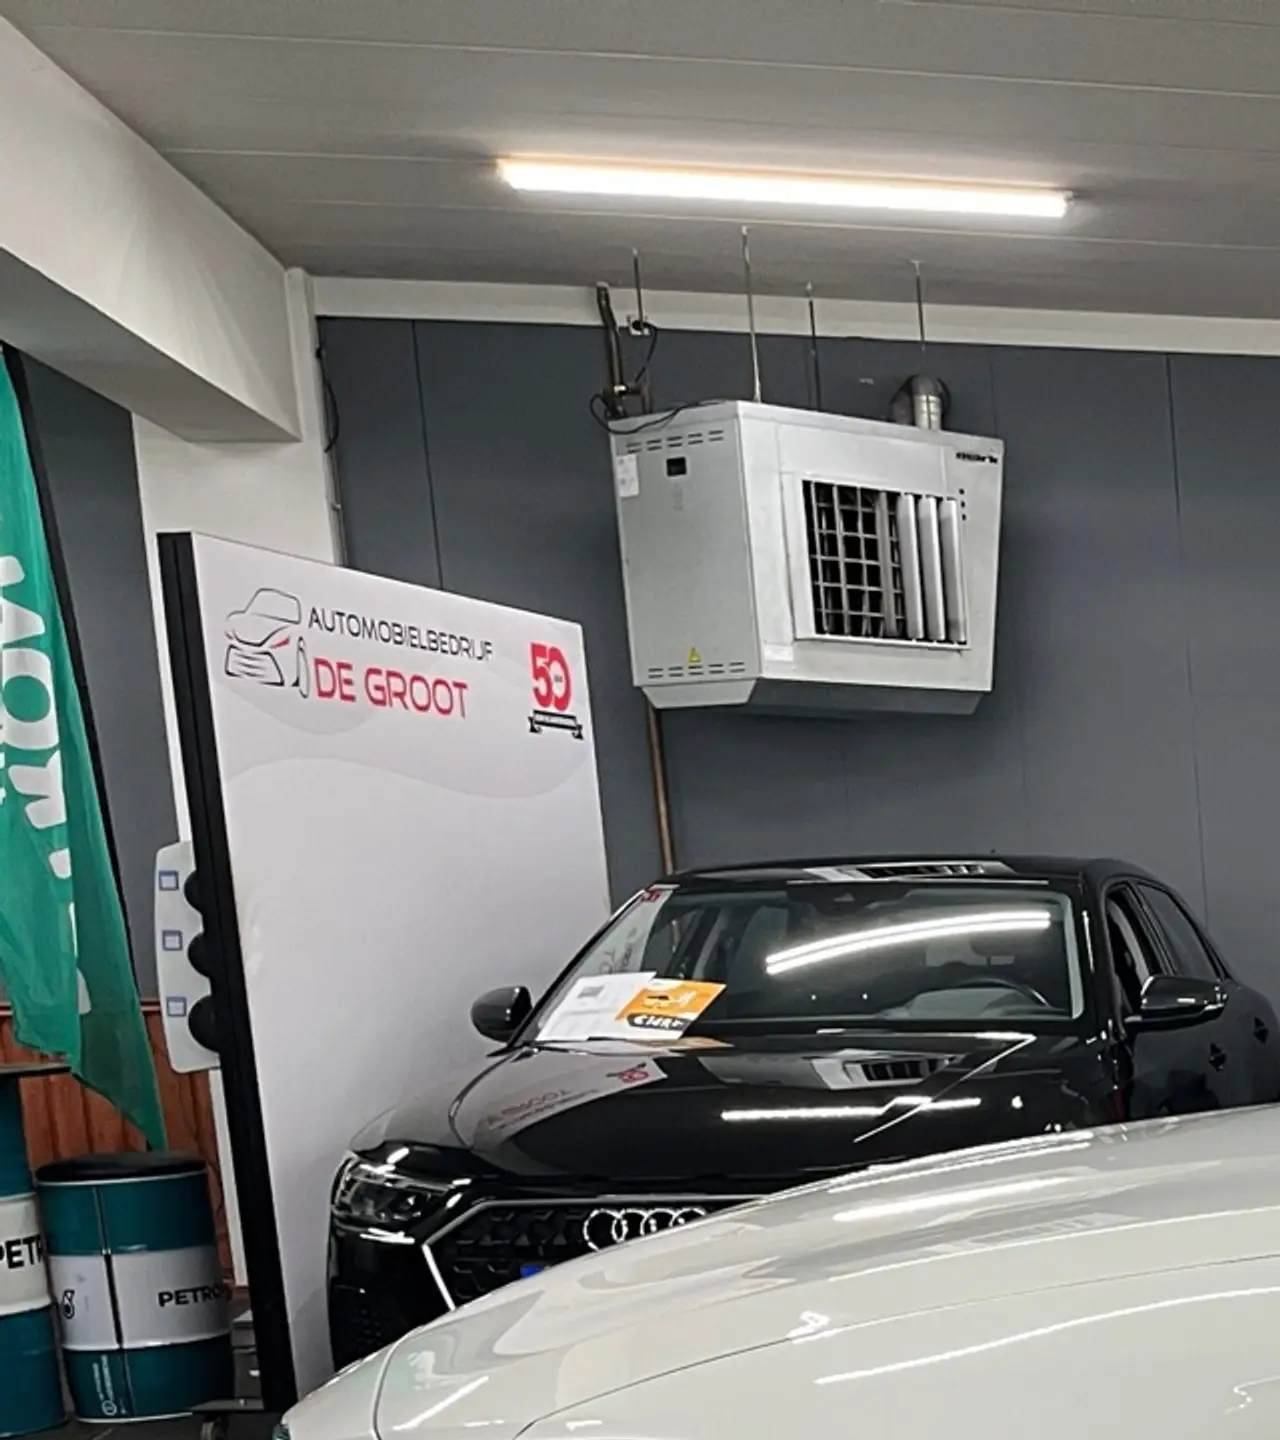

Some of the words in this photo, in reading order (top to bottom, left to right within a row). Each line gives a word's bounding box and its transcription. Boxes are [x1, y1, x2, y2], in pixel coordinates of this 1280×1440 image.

[308, 606, 493, 661] AUTOMOBIELBEDRIJF
[313, 657, 357, 703] DE
[364, 667, 469, 718] GROOT
[529, 641, 572, 712] 50
[0, 1234, 41, 1269] ET
